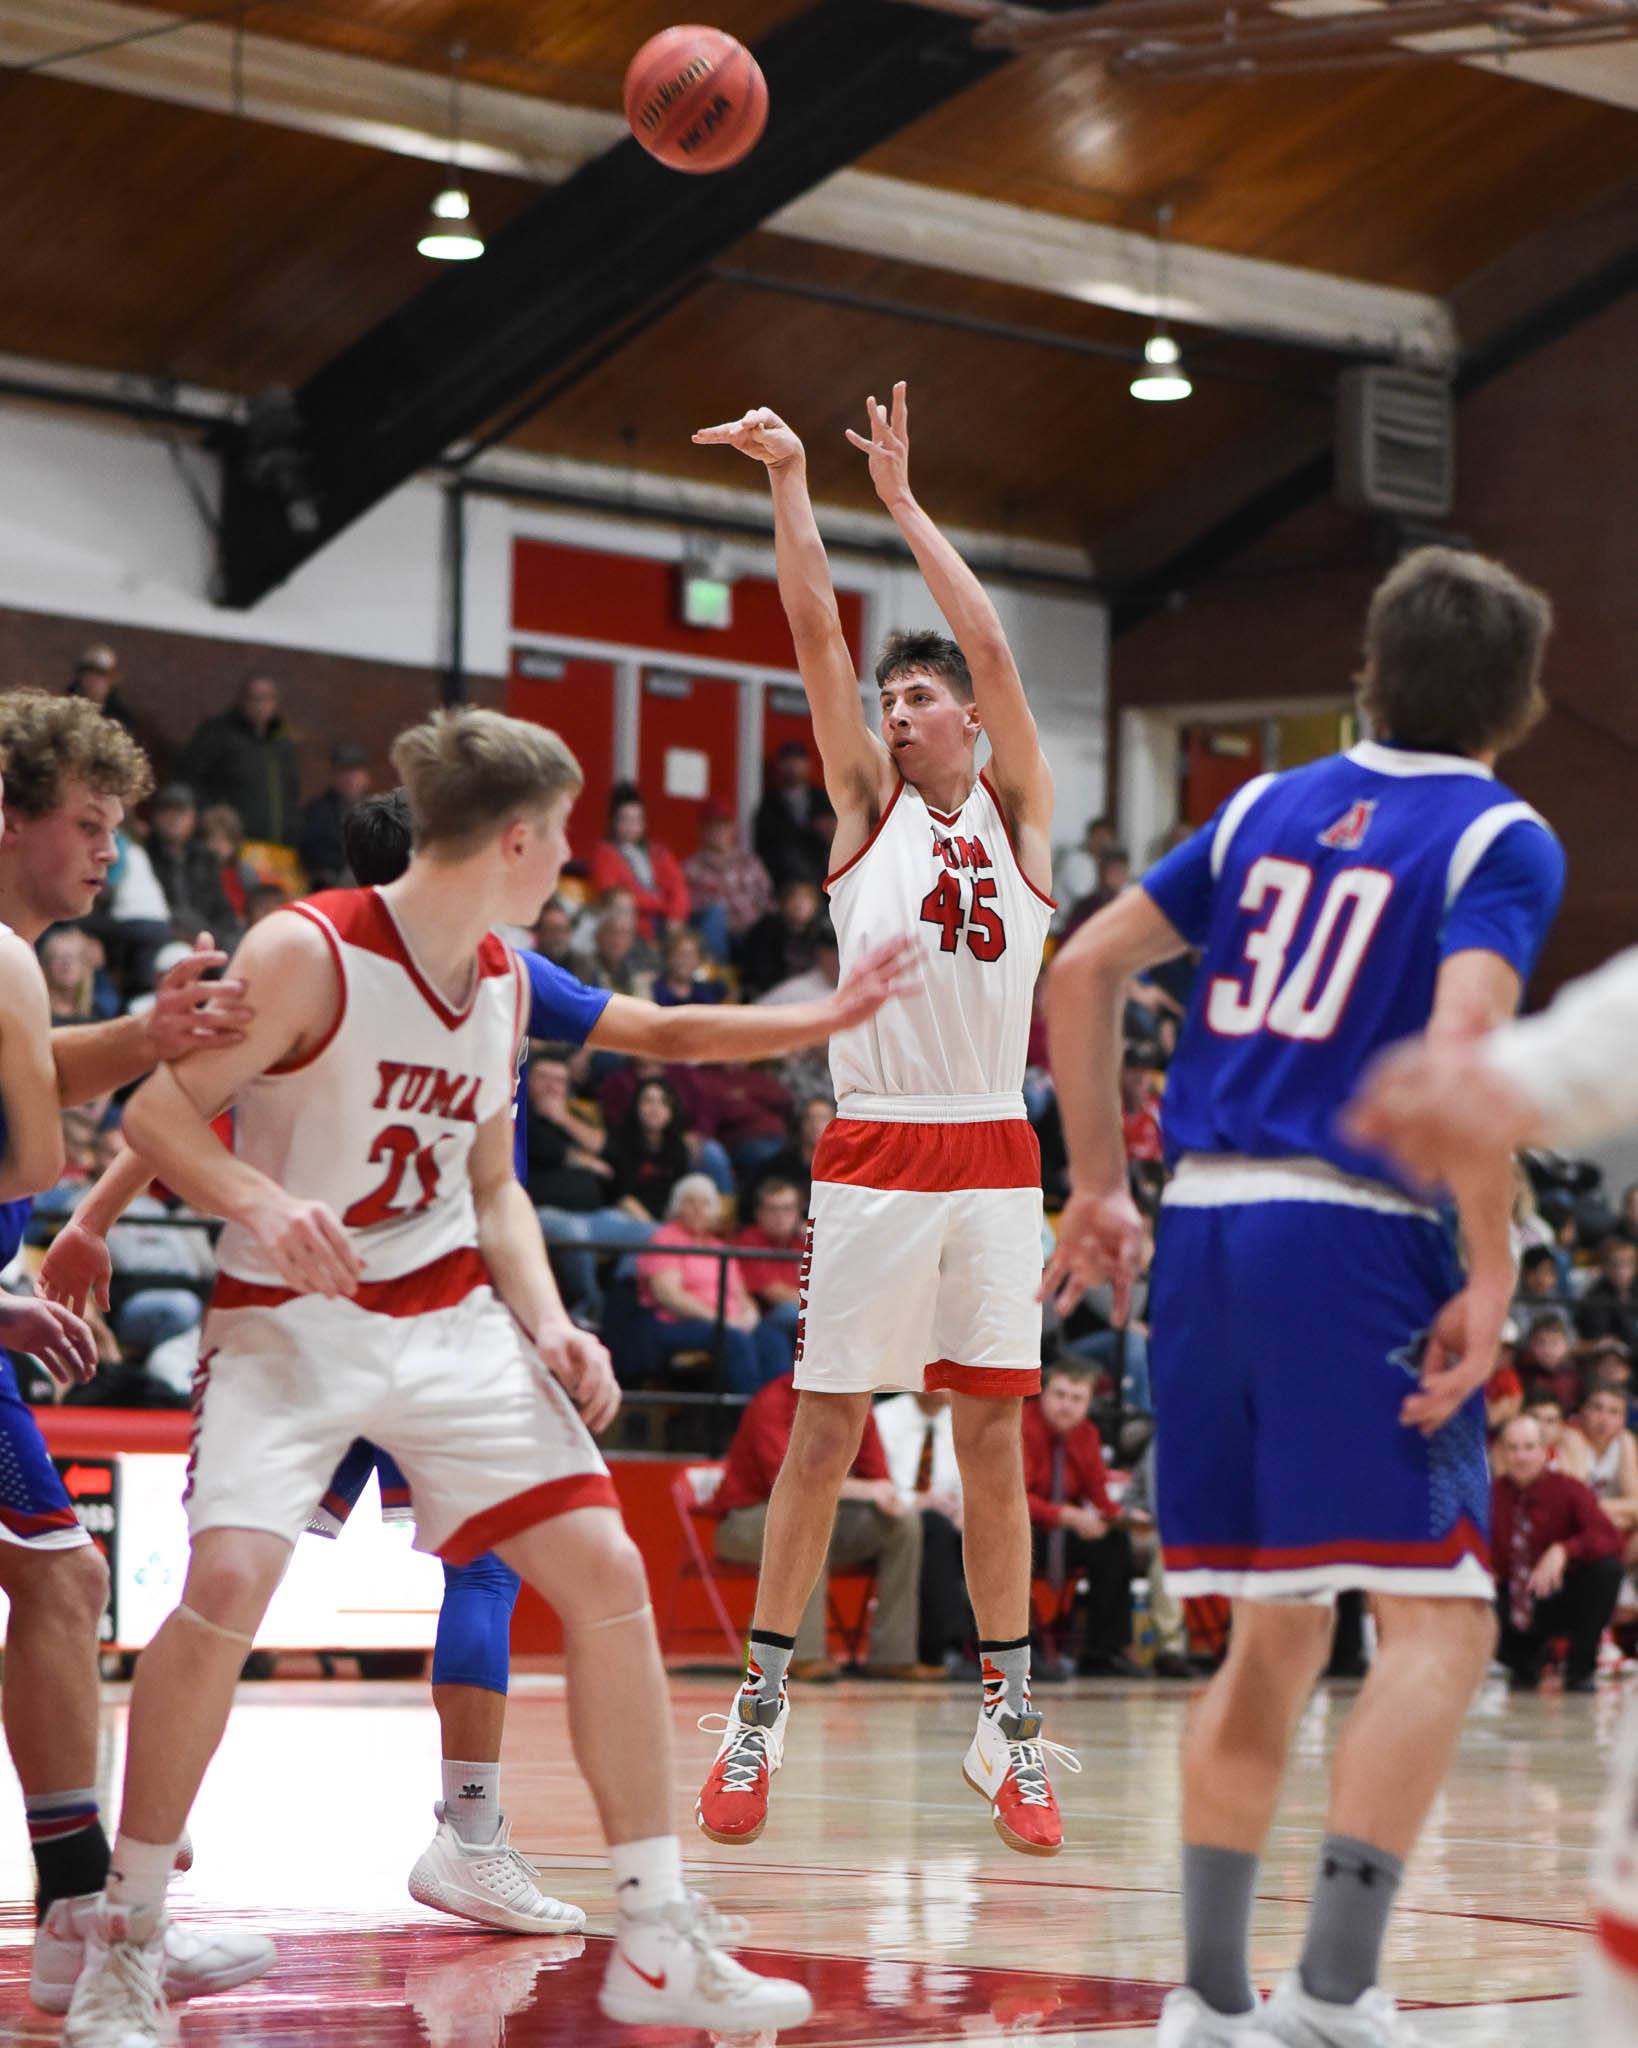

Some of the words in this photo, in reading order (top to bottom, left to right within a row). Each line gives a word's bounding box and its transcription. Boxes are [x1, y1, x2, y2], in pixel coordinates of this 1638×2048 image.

[639, 57, 714, 131] Wilson
[1316, 799, 1379, 850] A
[919, 868, 1007, 963] 45
[1206, 854, 1394, 1043] 30
